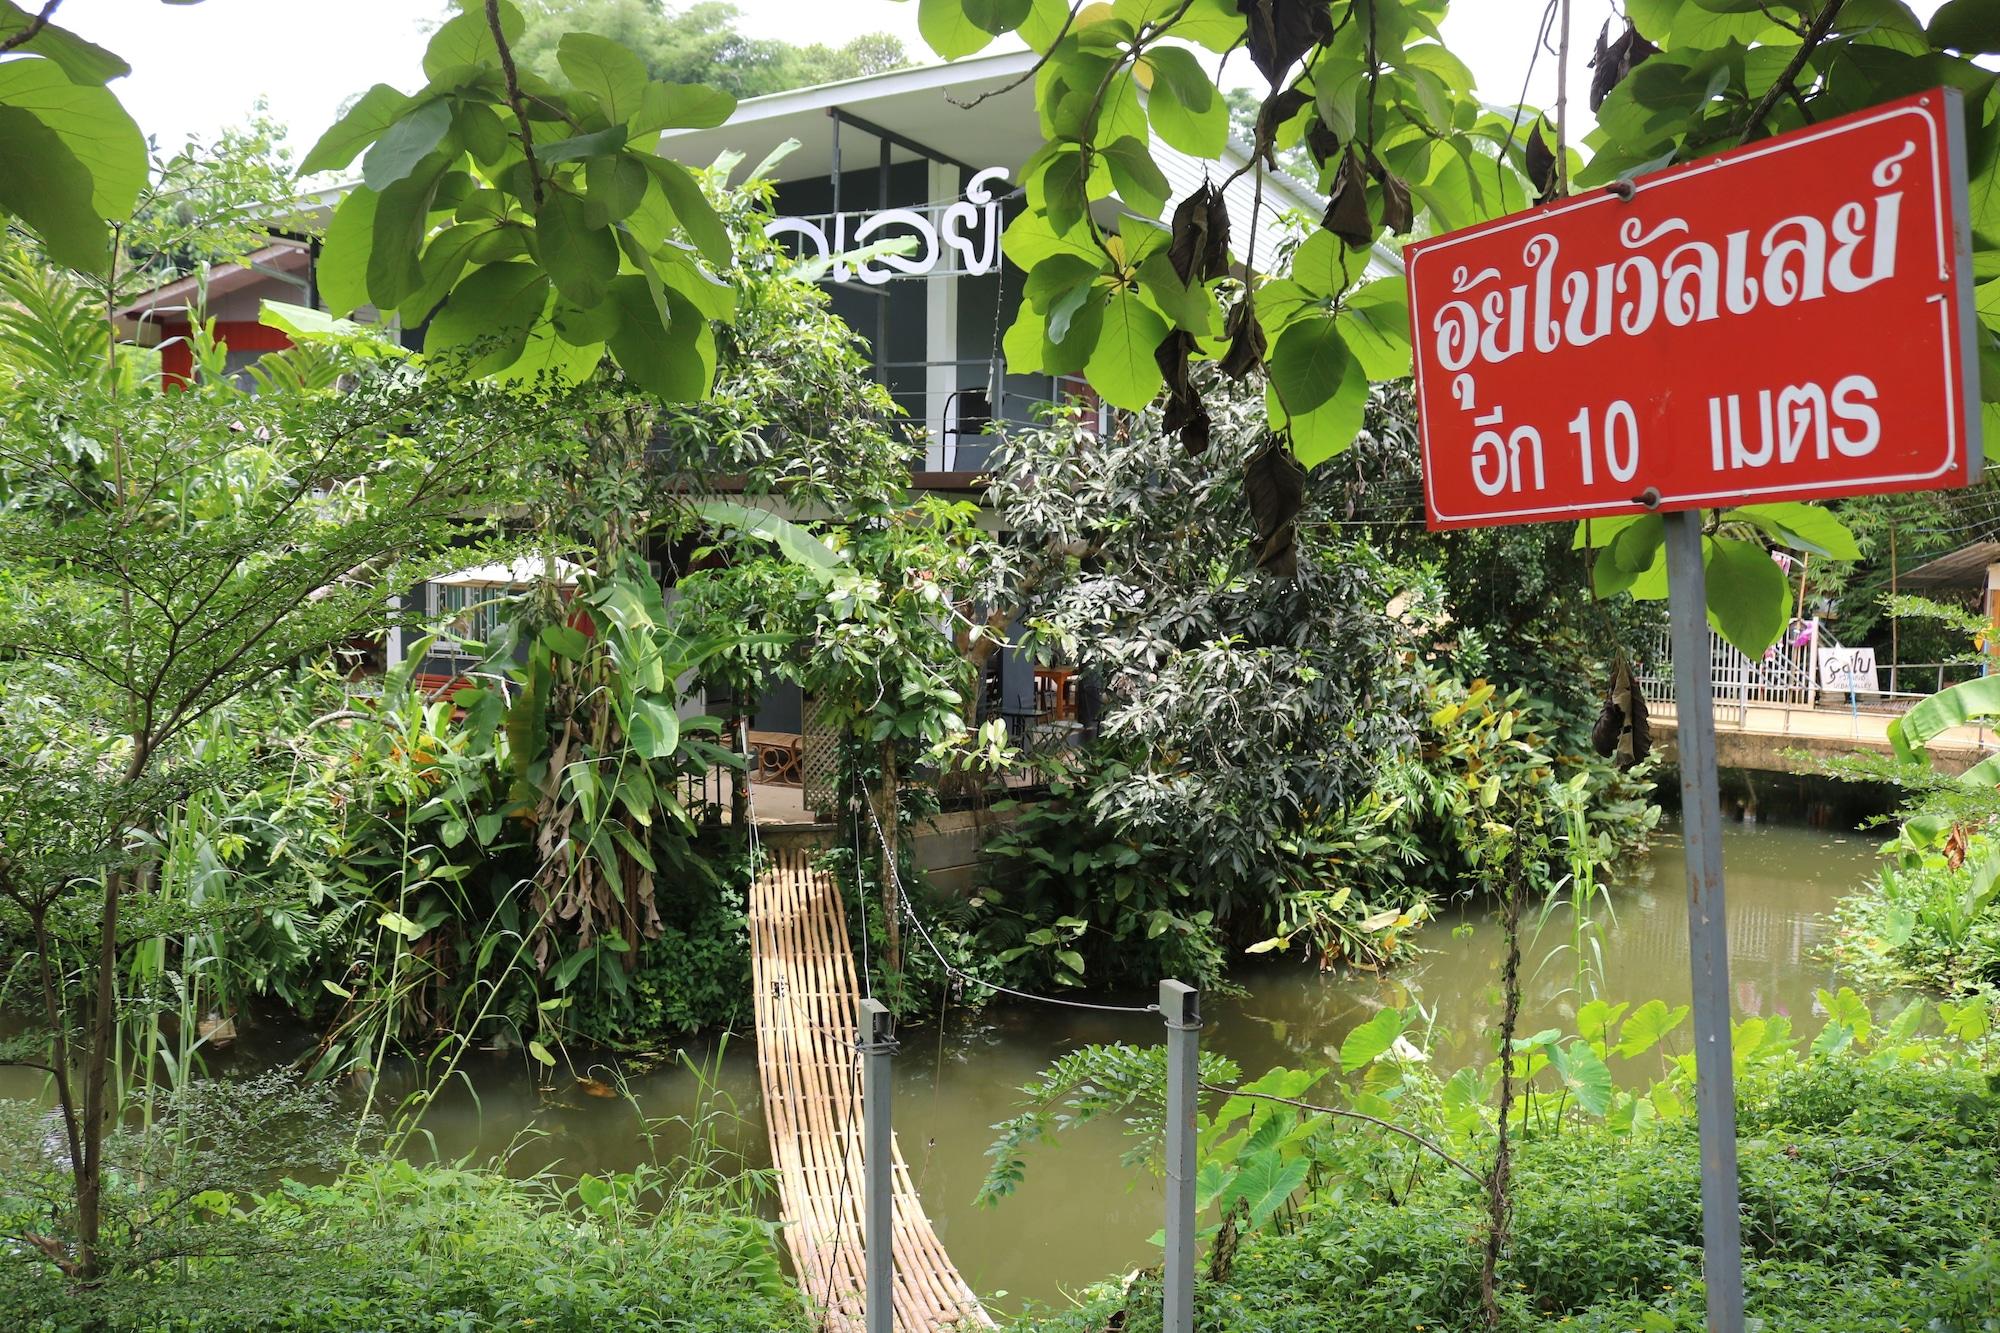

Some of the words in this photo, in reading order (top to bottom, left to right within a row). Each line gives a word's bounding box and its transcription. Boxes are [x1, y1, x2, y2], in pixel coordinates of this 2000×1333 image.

[1433, 141, 1916, 411] อุ้ยใบวัลเลย์
[1471, 406, 1546, 497] อีก
[1568, 400, 1639, 486] 10
[1708, 375, 1881, 471] เมตร
